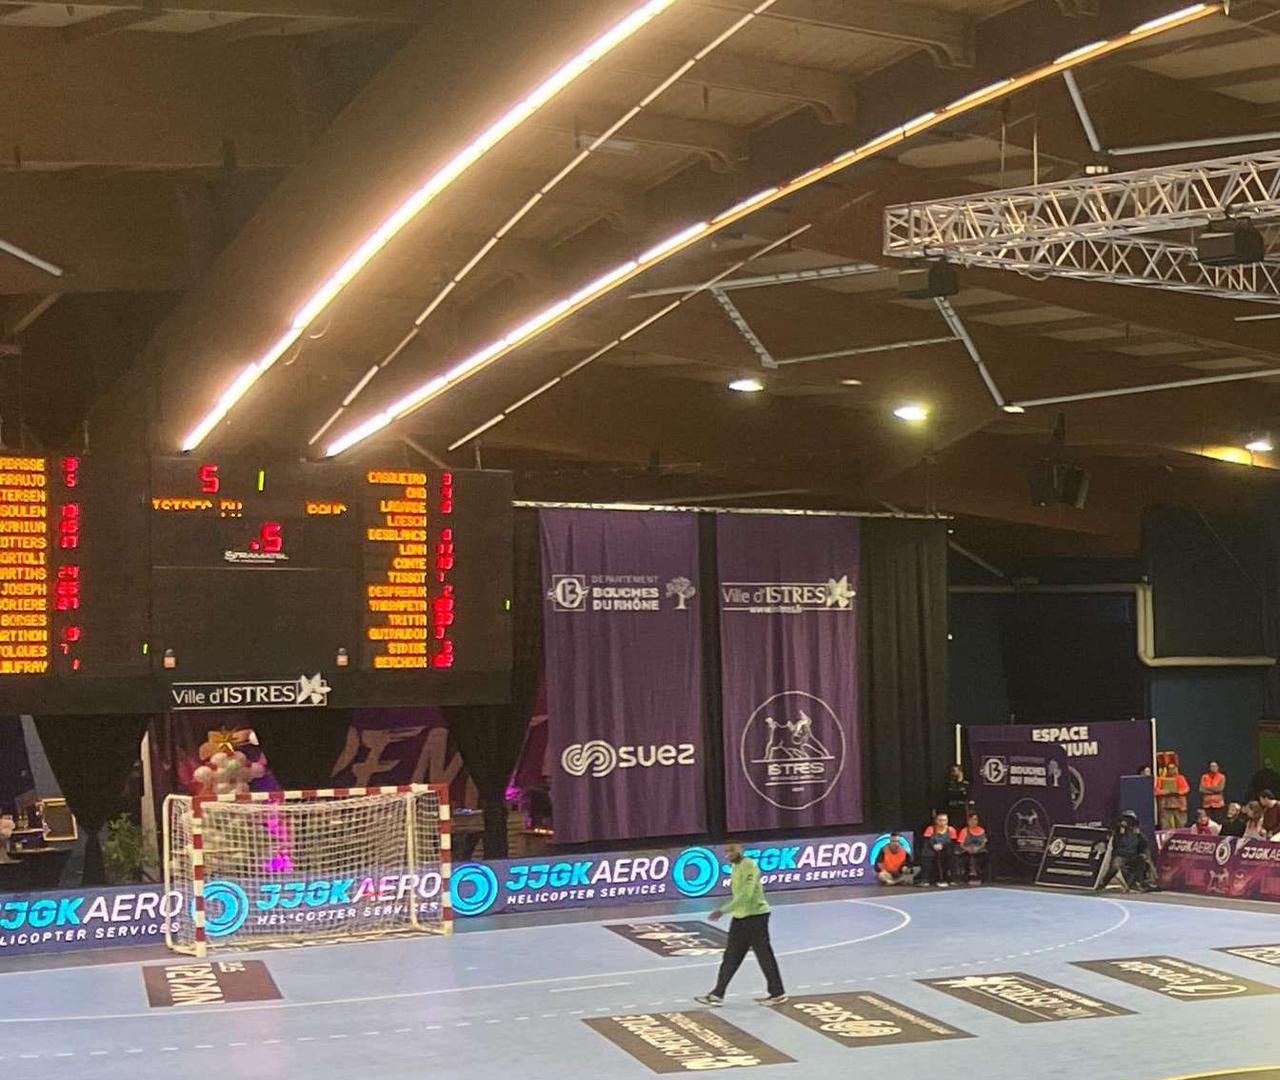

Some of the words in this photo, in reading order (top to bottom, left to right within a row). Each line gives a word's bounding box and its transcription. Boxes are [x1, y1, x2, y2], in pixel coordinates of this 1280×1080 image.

[200, 464, 219, 493] 5
[592, 587, 659, 598] BOUCHES
[722, 588, 750, 603] Ville
[753, 586, 825, 603] d'ISTRES
[592, 599, 612, 611] DU
[172, 690, 205, 705] Ville
[209, 686, 295, 704] d'ISTRES
[1031, 726, 1089, 742] ESPACE
[618, 743, 696, 768] suez
[505, 855, 669, 890] JJGKAERO
[805, 867, 865, 881] SERVICES
[506, 888, 595, 905] HELICOPTER
[600, 883, 667, 898] SERVICES
[0, 890, 184, 930] JGKAERO
[95, 922, 180, 939] SERVICES
